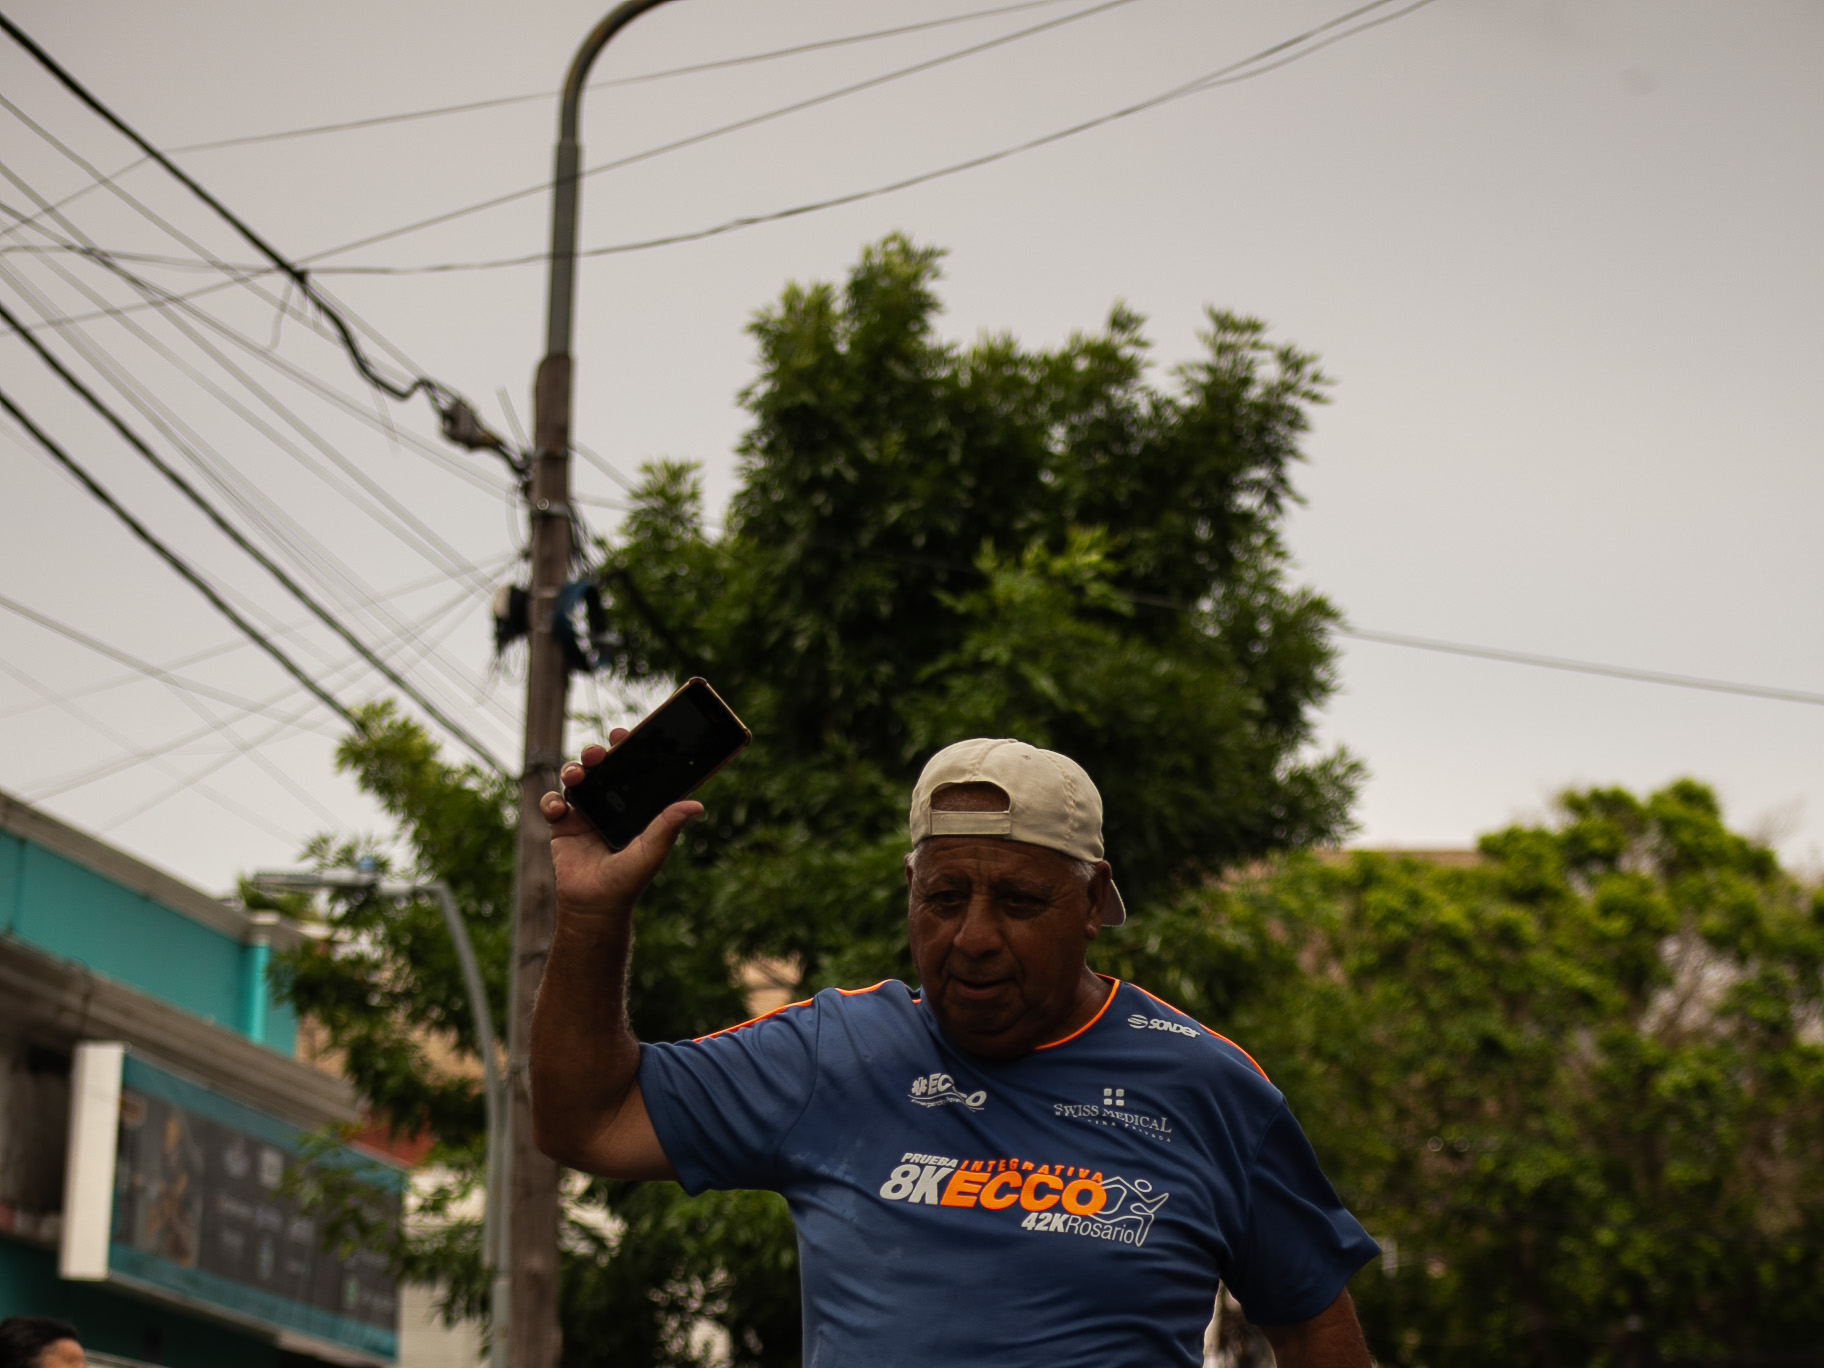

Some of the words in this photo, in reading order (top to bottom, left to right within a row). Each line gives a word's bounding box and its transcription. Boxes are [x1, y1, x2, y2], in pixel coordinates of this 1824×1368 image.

[1102, 1108, 1172, 1133] MEDICAL
[901, 1152, 959, 1168] PRUEBA
[960, 1158, 1103, 1183] INTEGRATIVA
